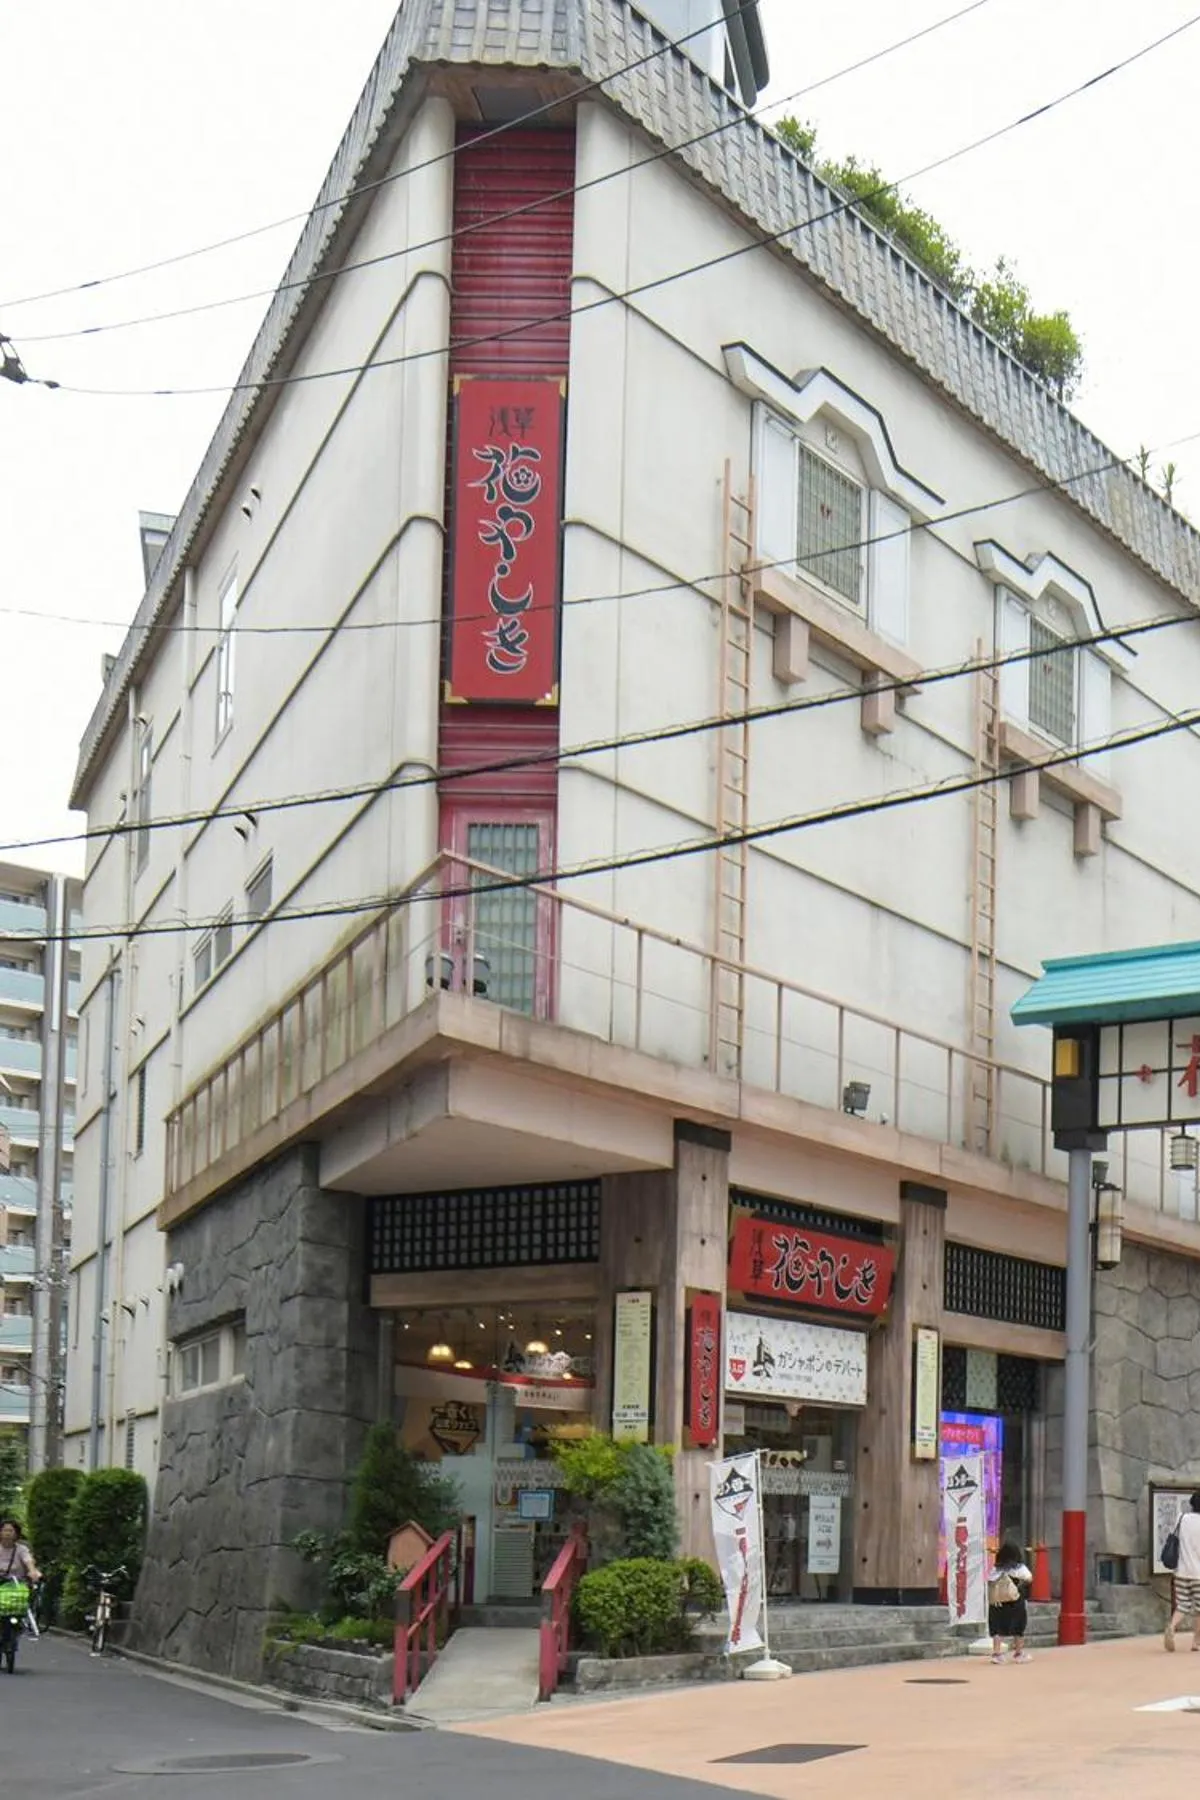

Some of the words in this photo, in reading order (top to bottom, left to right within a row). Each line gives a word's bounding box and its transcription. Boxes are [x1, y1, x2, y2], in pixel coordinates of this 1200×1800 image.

[488, 405, 536, 438] 浅草
[466, 442, 543, 675] 花やしき
[764, 1232, 878, 1305] 花やしき
[777, 1350, 863, 1379] ガシャポンのデパート
